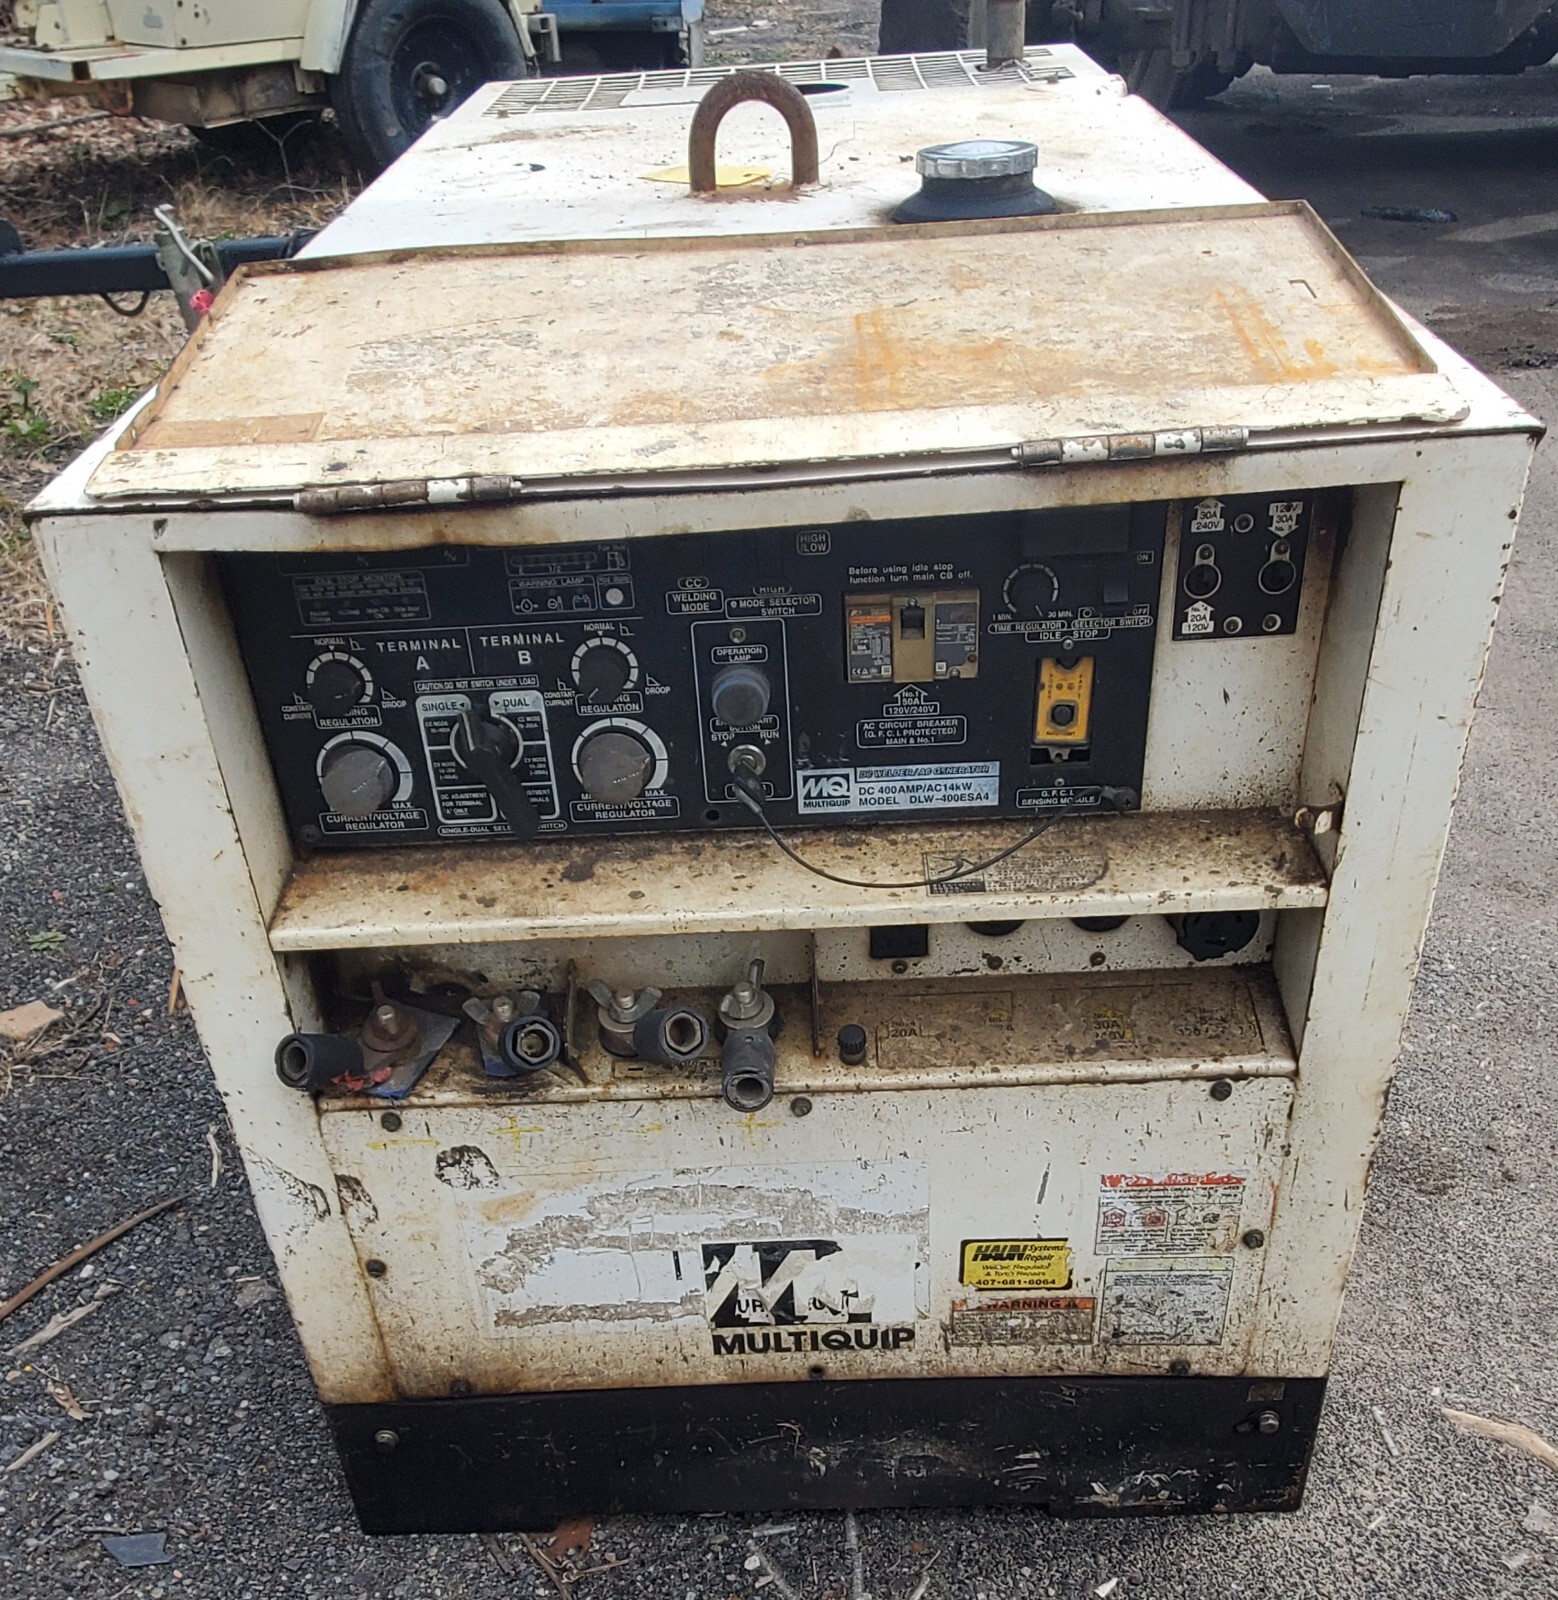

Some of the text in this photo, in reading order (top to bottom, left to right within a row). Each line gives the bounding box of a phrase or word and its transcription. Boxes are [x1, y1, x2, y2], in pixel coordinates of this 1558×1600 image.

[1200, 510, 1218, 519] 30A
[1275, 515, 1294, 524] 30A
[1196, 521, 1220, 530] 240V
[800, 533, 826, 543] HIGH
[848, 563, 954, 575] Before using idle stop
[850, 570, 973, 584] function turn main CB off.
[685, 578, 702, 588] CC
[672, 592, 717, 602] WELDING
[740, 596, 816, 608] MODE SELECTOR
[682, 602, 710, 612] MODE
[761, 606, 795, 616] SWITCH
[1132, 608, 1148, 616] OFF
[1048, 610, 1074, 618] 30 MIN.
[1190, 614, 1208, 623] 20A
[584, 622, 615, 631] NORMAL
[994, 622, 1062, 632] TIME REGULATOR
[1074, 618, 1150, 628] SELECTOR SWITCH
[1186, 624, 1210, 632] 120V
[480, 632, 565, 648] TERMINAL
[1040, 630, 1098, 640] IDLE STOP
[314, 638, 346, 646] NORMAL
[376, 638, 462, 653] TERMINAL
[716, 647, 763, 656] OPERATION
[518, 650, 532, 665] B
[728, 654, 751, 662] LAMP
[416, 656, 430, 671] A
[456, 680, 468, 689] NOT
[471, 679, 494, 688] SWITCH
[496, 678, 518, 687] UNDER
[520, 677, 536, 686] LOAD
[544, 690, 576, 699] CONSTANT
[644, 686, 671, 695] DROOP
[902, 690, 920, 698] No.1
[382, 700, 407, 709] DROOP
[422, 700, 458, 712] SINGLE
[502, 698, 530, 708] DUAL
[902, 698, 920, 706] 50A
[580, 703, 640, 714] REGULATION
[888, 706, 935, 715] 120V/240V
[320, 717, 378, 727] REGULATION
[863, 719, 958, 731] AC CIRCUIT BREAKER
[711, 732, 735, 741] STOP
[760, 731, 779, 739] RUN
[859, 770, 874, 779] DC
[933, 765, 990, 776] GENERATOR
[801, 776, 850, 798] MQ
[859, 786, 875, 796] DC
[859, 792, 990, 806] MODEL DLW-400ESA4
[1022, 796, 1095, 806] SENSING MOULE
[804, 800, 851, 809] MULTIQUIP
[595, 809, 656, 819] REGULATOR
[346, 821, 405, 831] REGULATOR
[892, 1028, 918, 1038] 20A
[972, 1244, 1064, 1261] HAUN Systems
[1024, 1254, 1055, 1263] Repair
[1016, 1270, 1046, 1278] Repairs
[712, 1328, 915, 1356] MULTIQUIP
